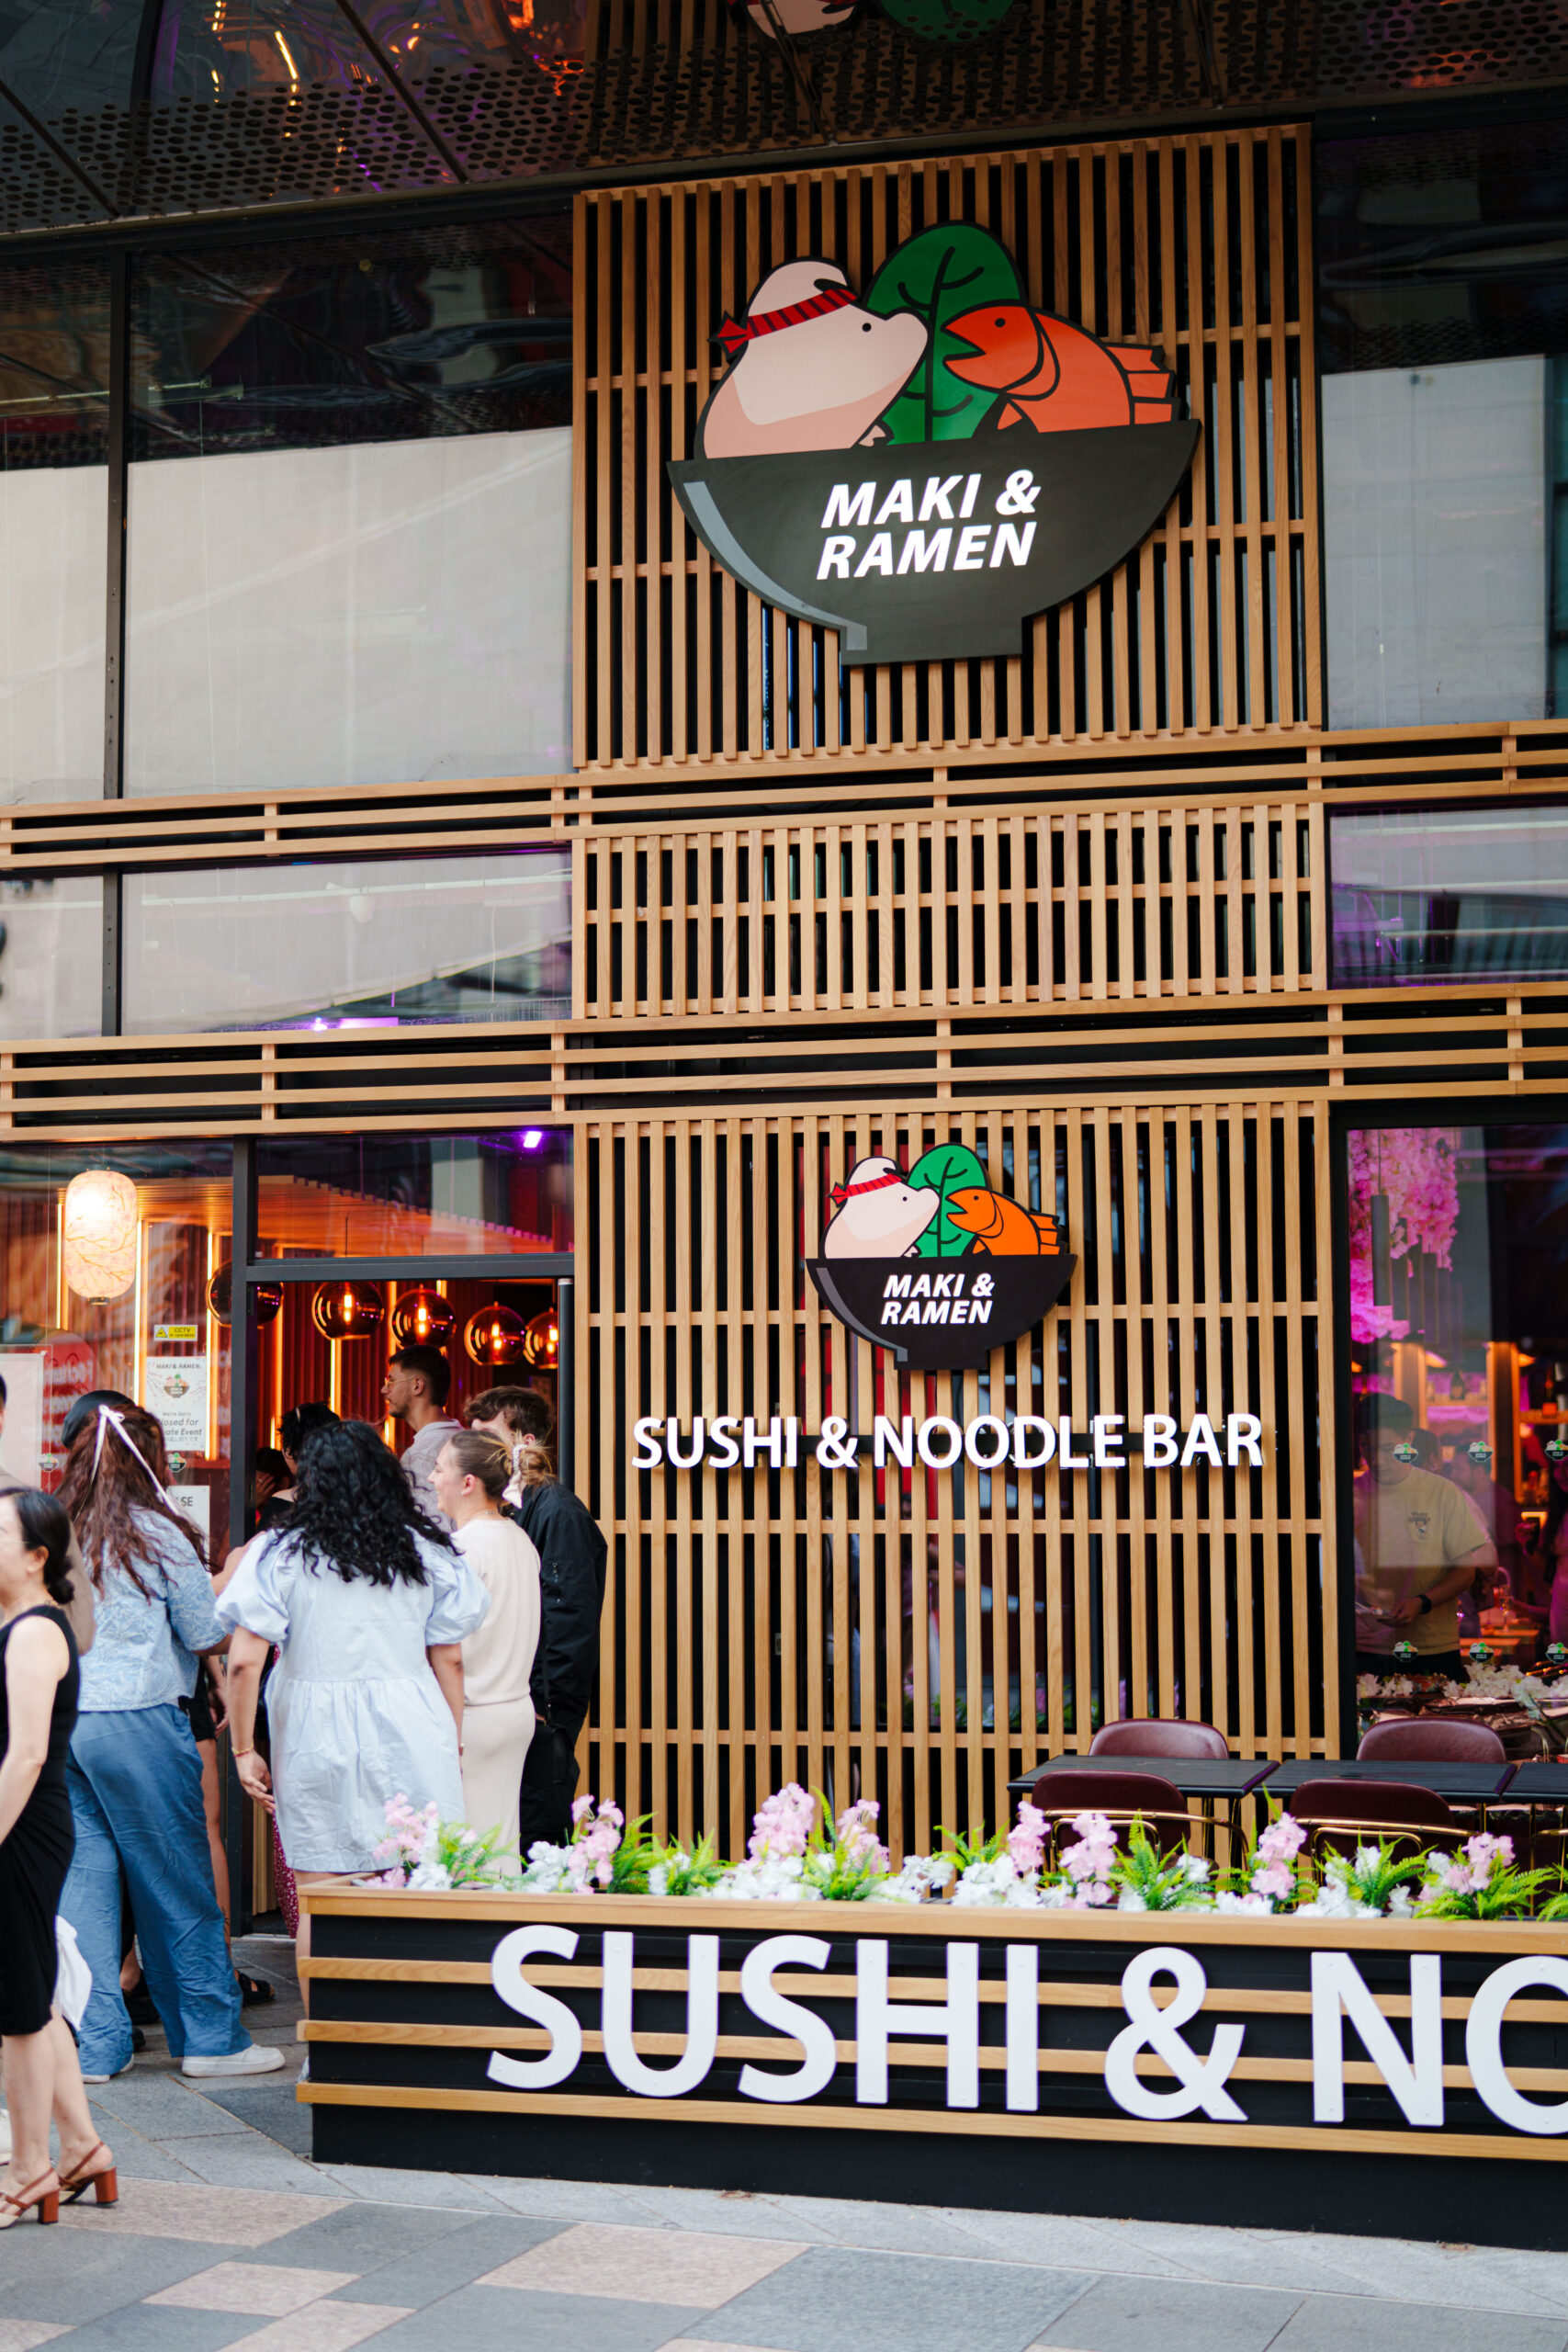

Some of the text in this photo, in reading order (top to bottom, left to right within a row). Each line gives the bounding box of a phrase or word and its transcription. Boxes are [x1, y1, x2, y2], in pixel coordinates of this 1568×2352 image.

[820, 469, 1042, 529] MAKI &
[816, 521, 1037, 581] RAMEN
[880, 1300, 993, 1325] RAMEN
[883, 1272, 995, 1298] MAKI &
[161, 1418, 199, 1426] losed for
[631, 1412, 1263, 1469] SUSHI & NOODLE BAR
[487, 1925, 1040, 2111] SUSHI
[1104, 1947, 1247, 2120] &
